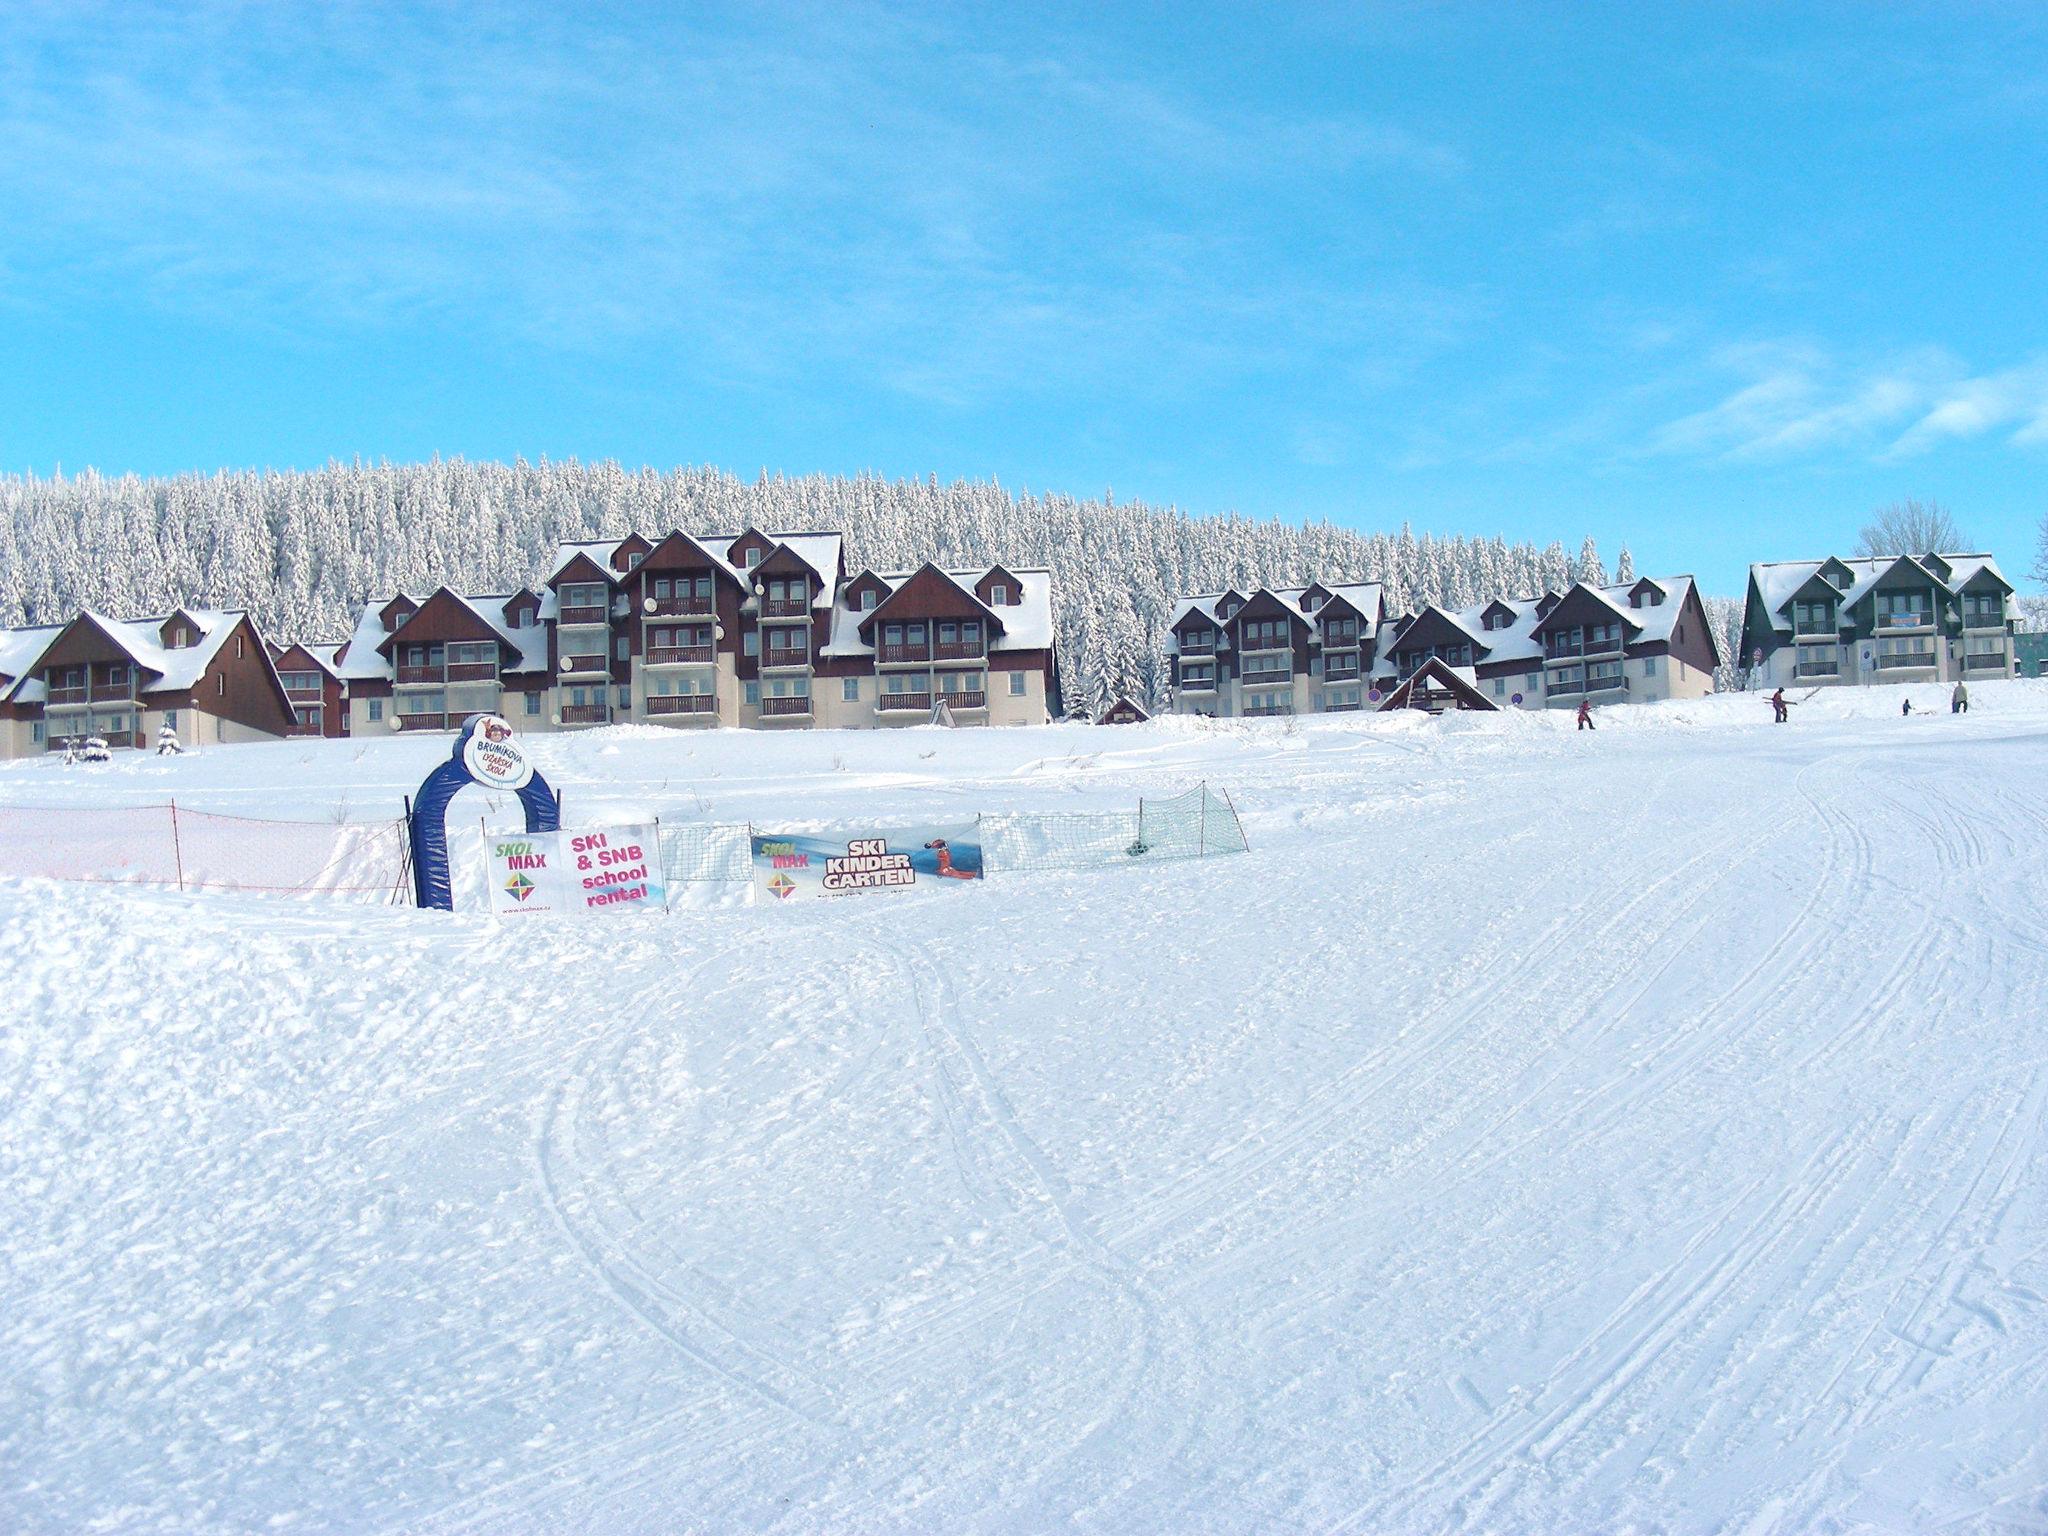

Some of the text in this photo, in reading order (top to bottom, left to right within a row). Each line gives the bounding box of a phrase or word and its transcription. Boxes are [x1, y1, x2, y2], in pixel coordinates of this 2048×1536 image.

[496, 842, 533, 857] SKOL
[571, 833, 607, 852] SKI
[761, 843, 796, 855] SKOL
[848, 839, 887, 857] SKI
[508, 854, 547, 870] MAX
[577, 845, 643, 870] & SNB
[773, 855, 809, 868] MAX
[825, 854, 912, 874] KINDER
[582, 864, 648, 889] school
[822, 868, 916, 889] GARTEN
[586, 883, 648, 907] rental
